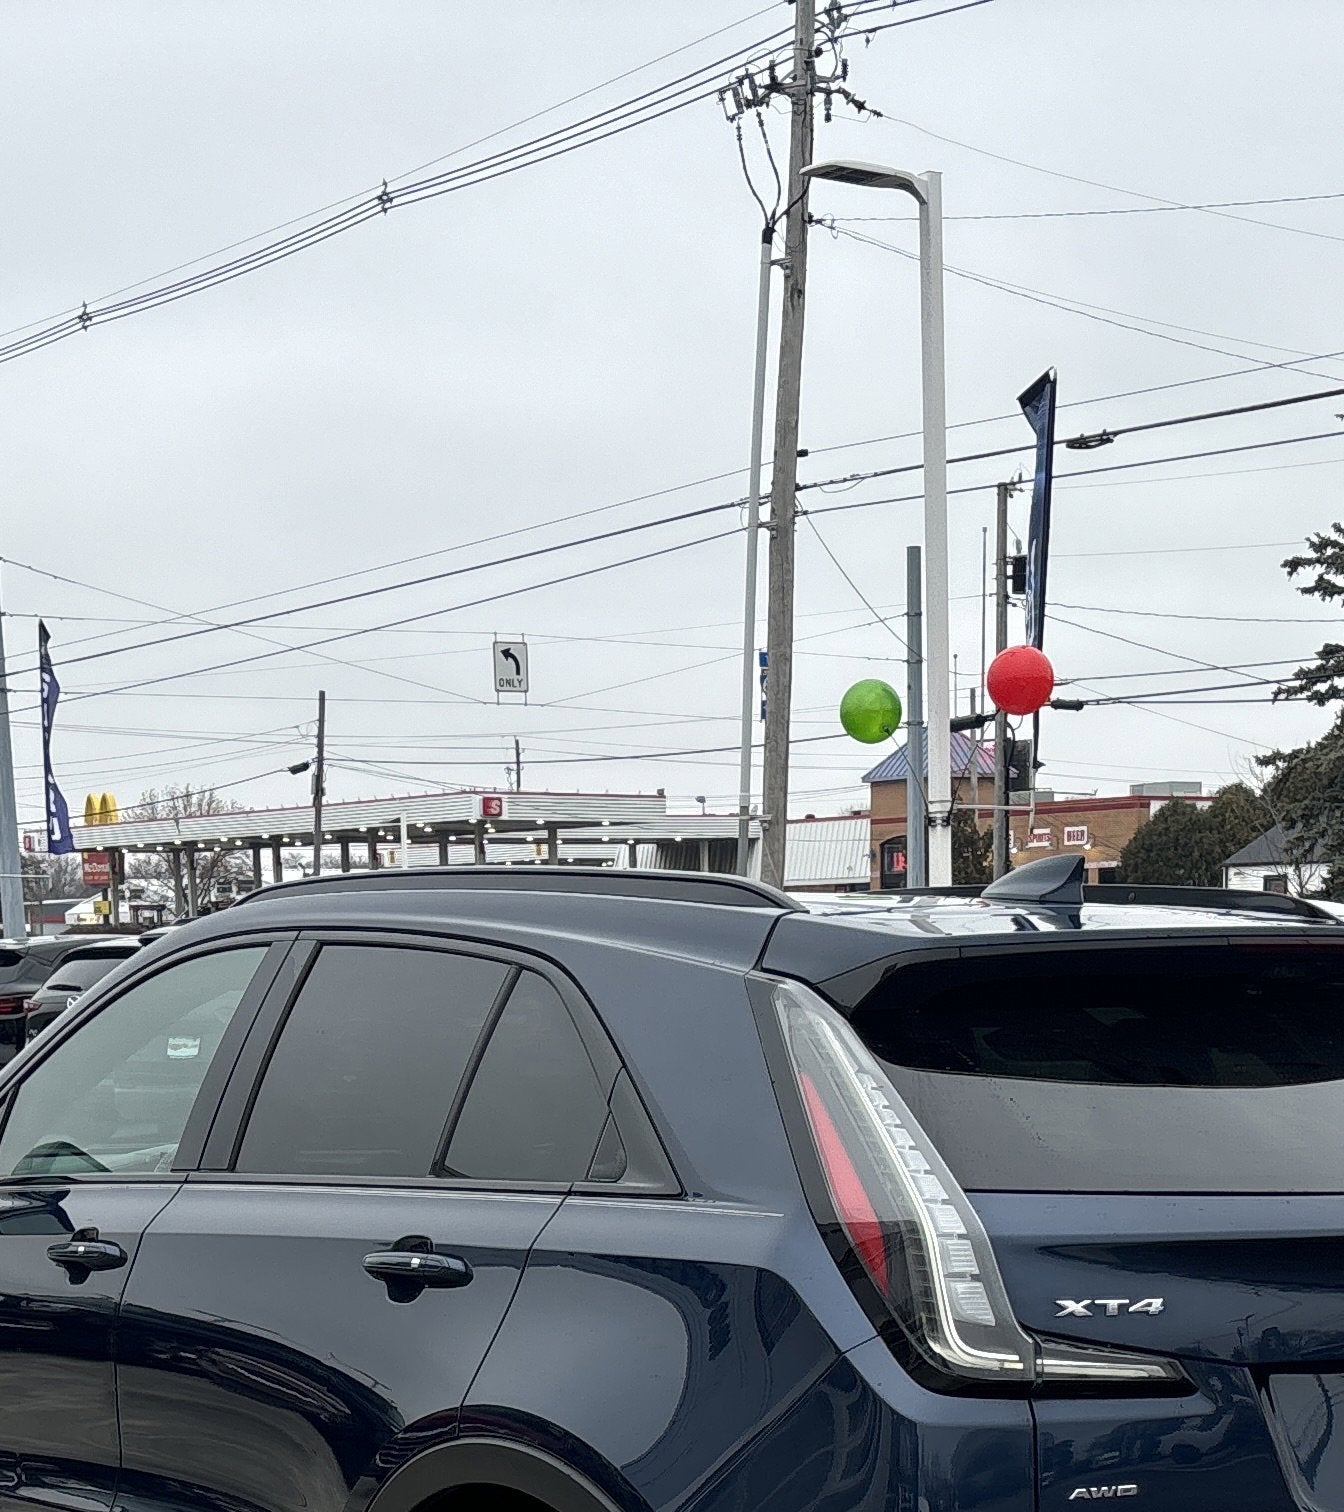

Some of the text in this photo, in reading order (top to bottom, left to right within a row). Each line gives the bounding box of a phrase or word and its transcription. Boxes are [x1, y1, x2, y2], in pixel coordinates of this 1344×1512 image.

[498, 677, 524, 688] ONLY
[1066, 829, 1086, 843] BEER
[1054, 1298, 1165, 1317] XT4
[1068, 1484, 1138, 1501] AWD
